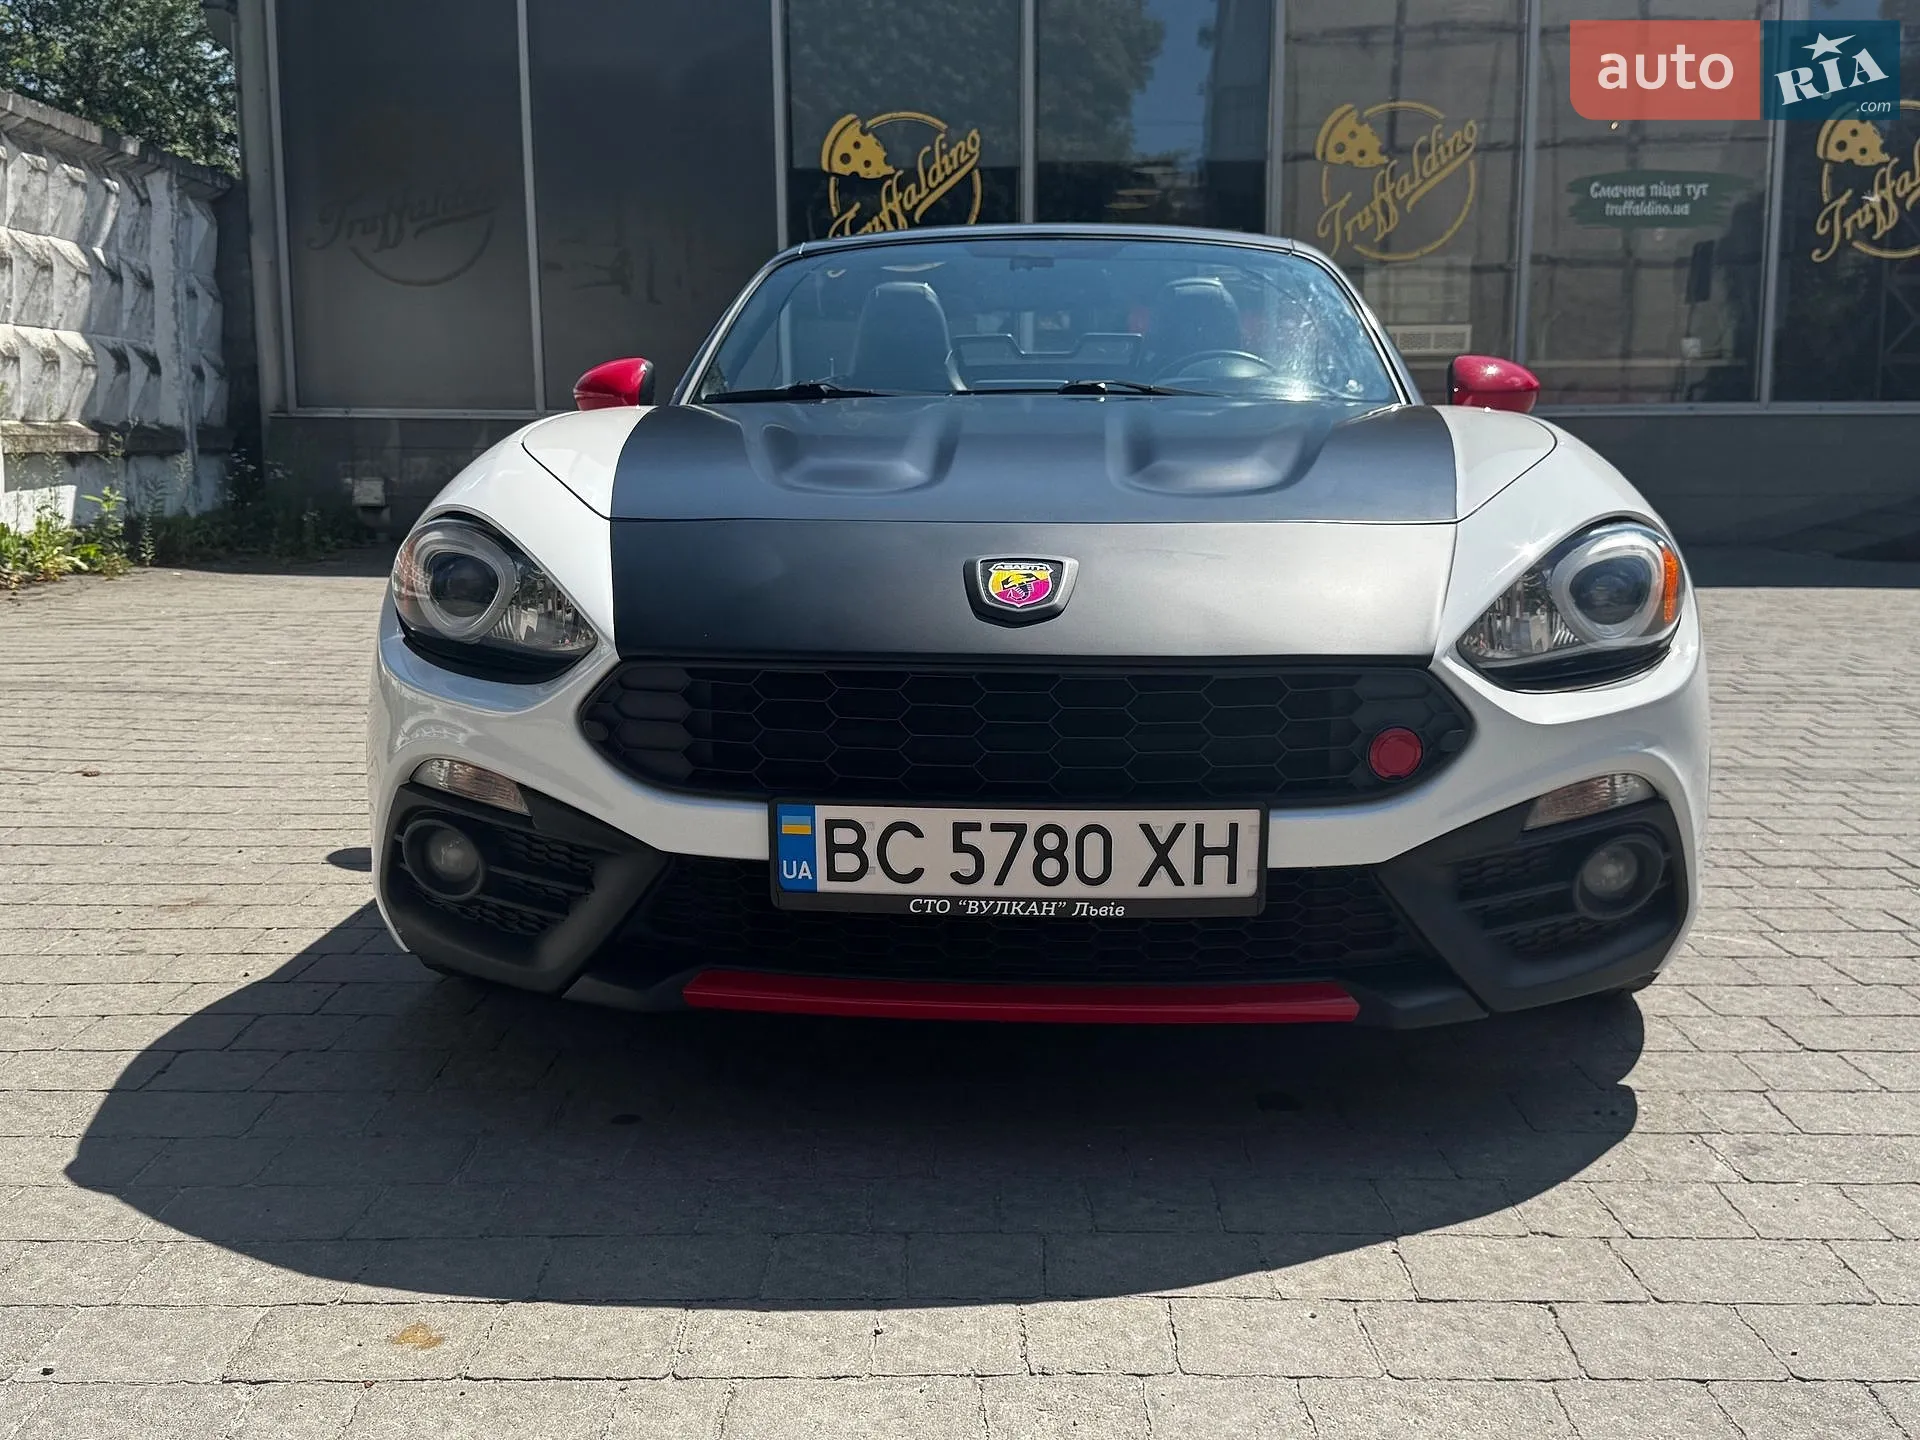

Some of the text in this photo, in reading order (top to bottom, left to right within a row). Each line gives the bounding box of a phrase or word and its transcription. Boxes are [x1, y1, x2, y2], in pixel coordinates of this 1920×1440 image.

[1316, 119, 1477, 257] Truffaldino
[1589, 181, 1710, 201] Смачна піца тут
[1604, 200, 1691, 216] truffaldino.ua
[824, 818, 1240, 888] BC 5780 XH
[782, 860, 813, 880] UA
[909, 898, 951, 914] СТО
[1071, 901, 1126, 917] Львів
